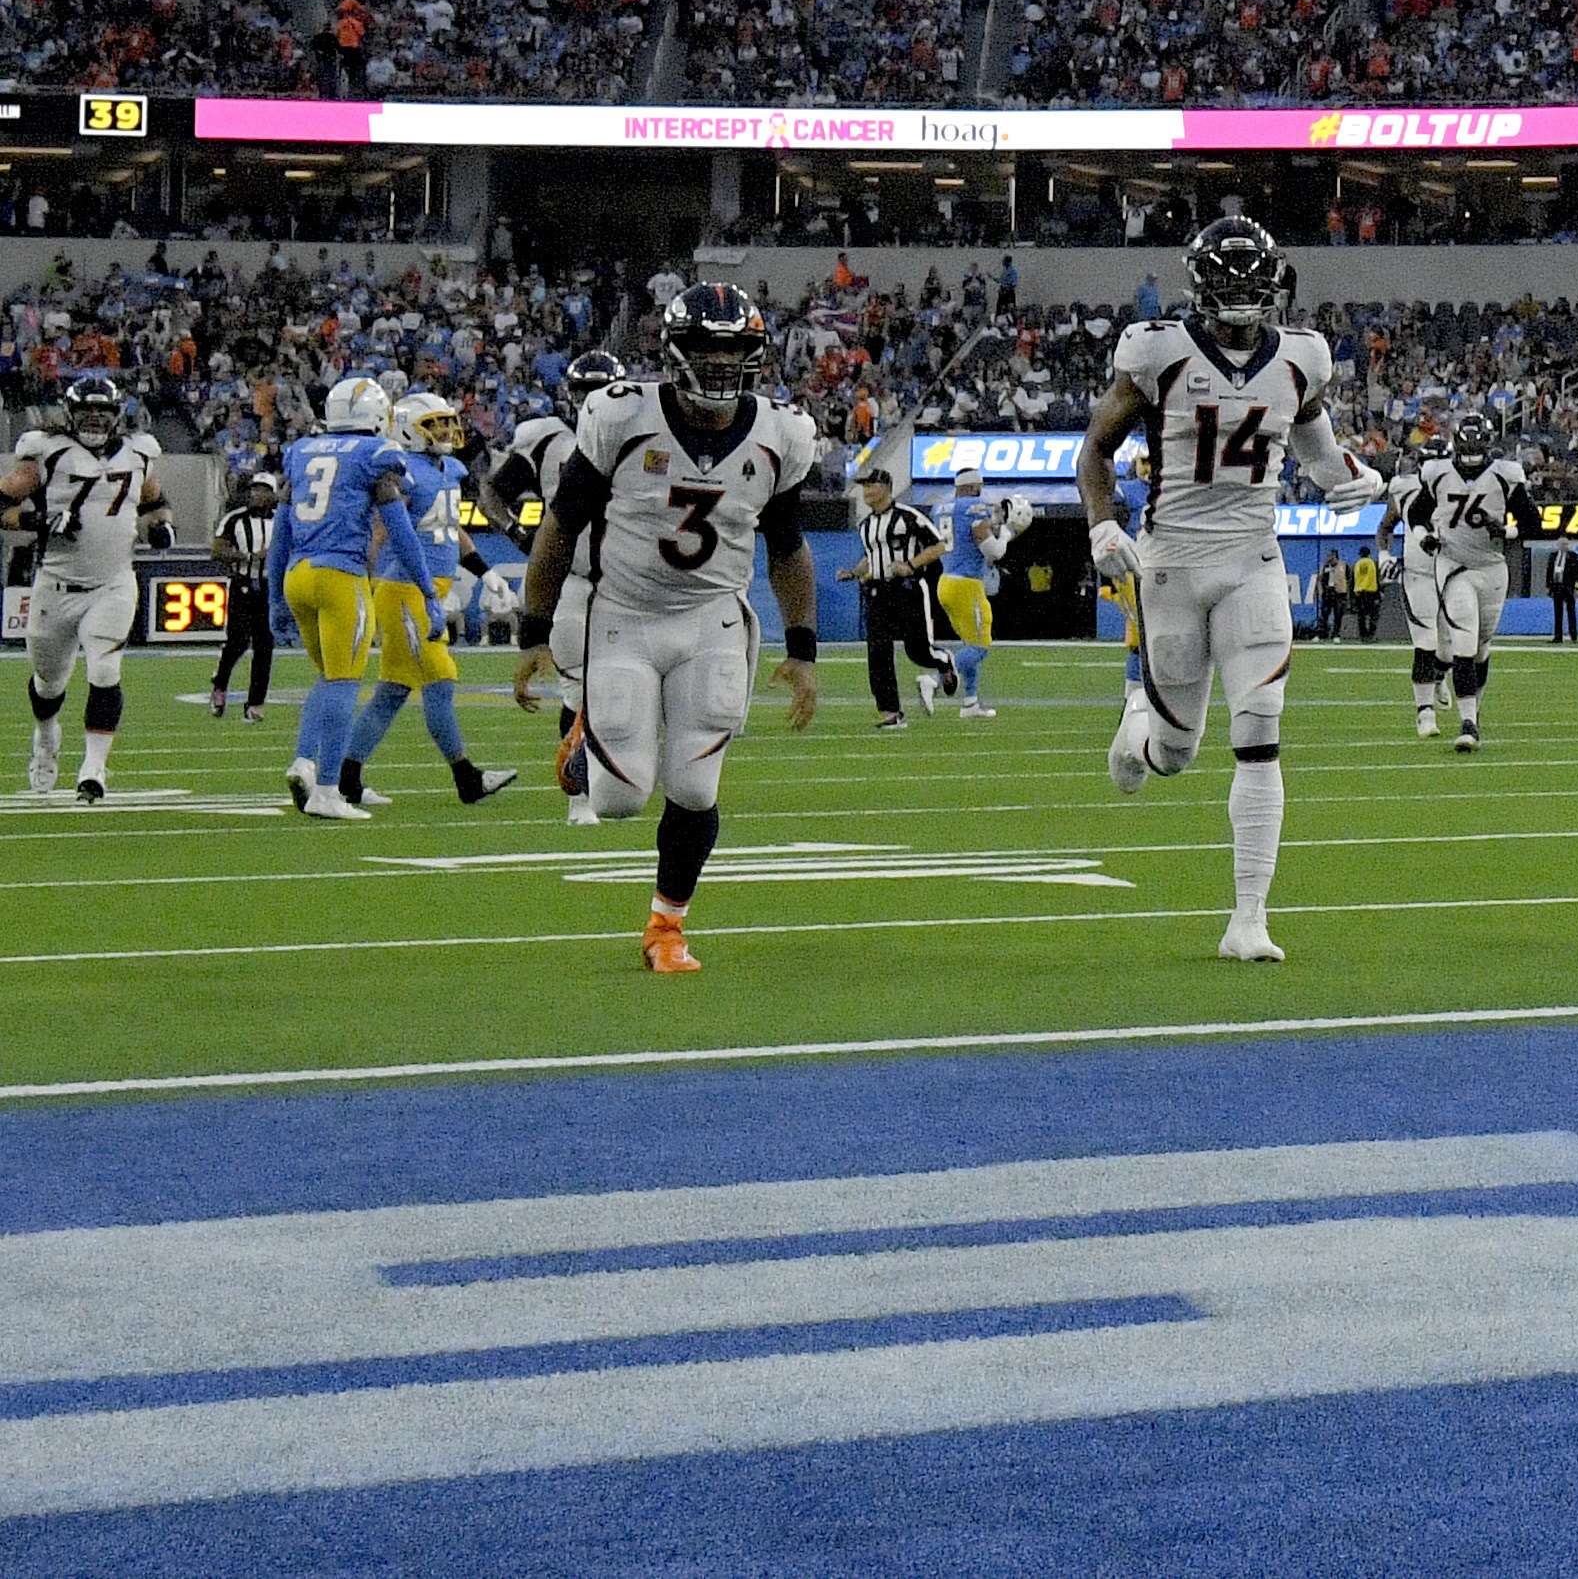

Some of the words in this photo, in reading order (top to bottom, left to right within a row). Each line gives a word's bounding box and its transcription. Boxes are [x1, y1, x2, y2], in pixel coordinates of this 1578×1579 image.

[87, 100, 141, 131] 39
[624, 116, 763, 141] INTERCEPT
[793, 118, 896, 142] CANCER
[1309, 111, 1523, 147] #BOLTUP
[1193, 403, 1273, 485] 14
[69, 471, 134, 524] 77
[295, 456, 340, 522] 3
[1446, 493, 1489, 529] 76
[658, 484, 727, 571] 3
[164, 581, 226, 633] 39
